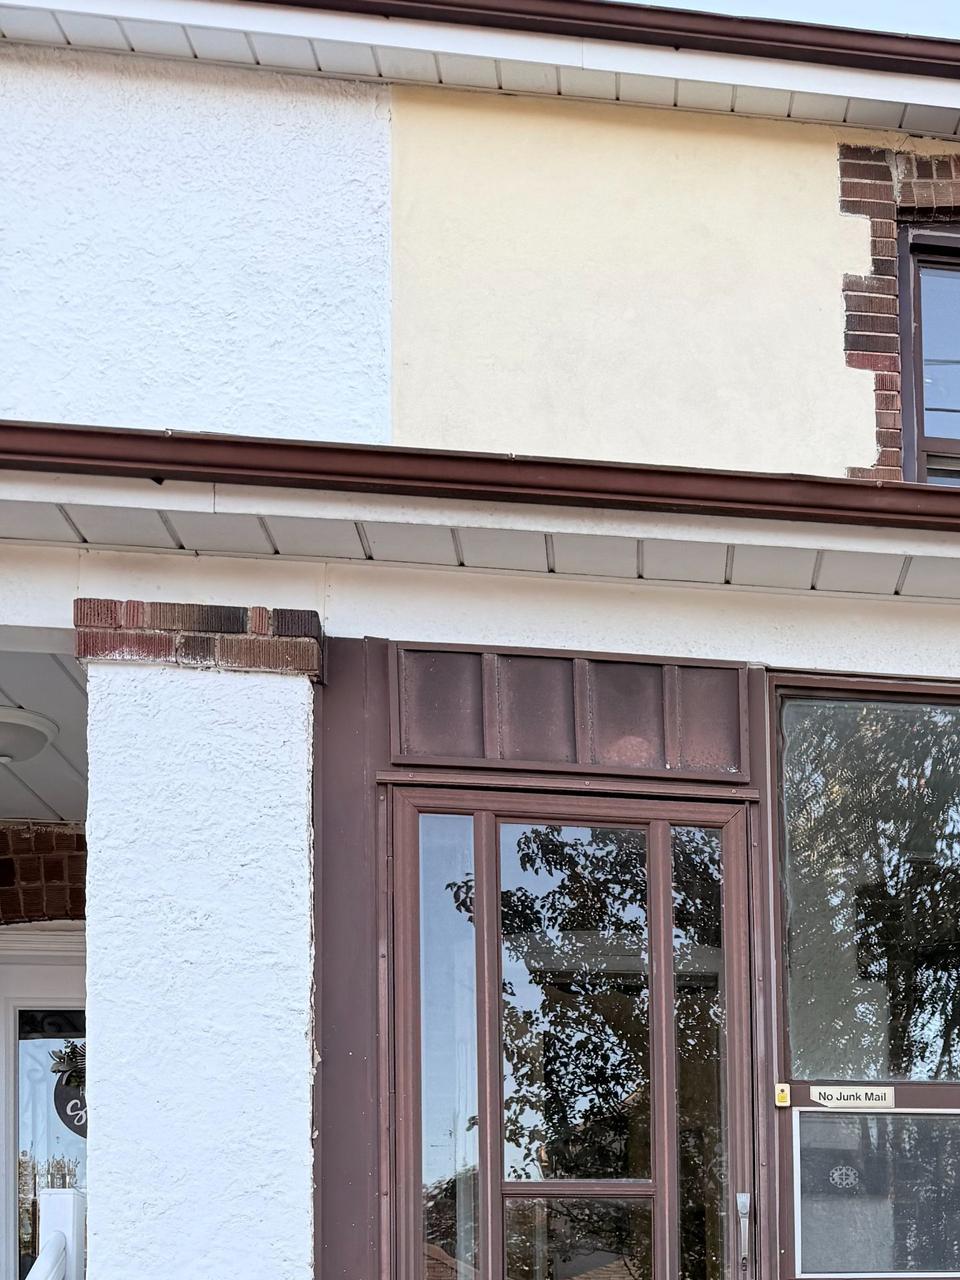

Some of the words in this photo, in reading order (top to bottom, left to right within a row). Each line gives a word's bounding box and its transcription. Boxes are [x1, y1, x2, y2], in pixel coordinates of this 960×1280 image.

[818, 1091, 833, 1102] No
[836, 1092, 861, 1102] Junk
[864, 1092, 887, 1102] Mail
